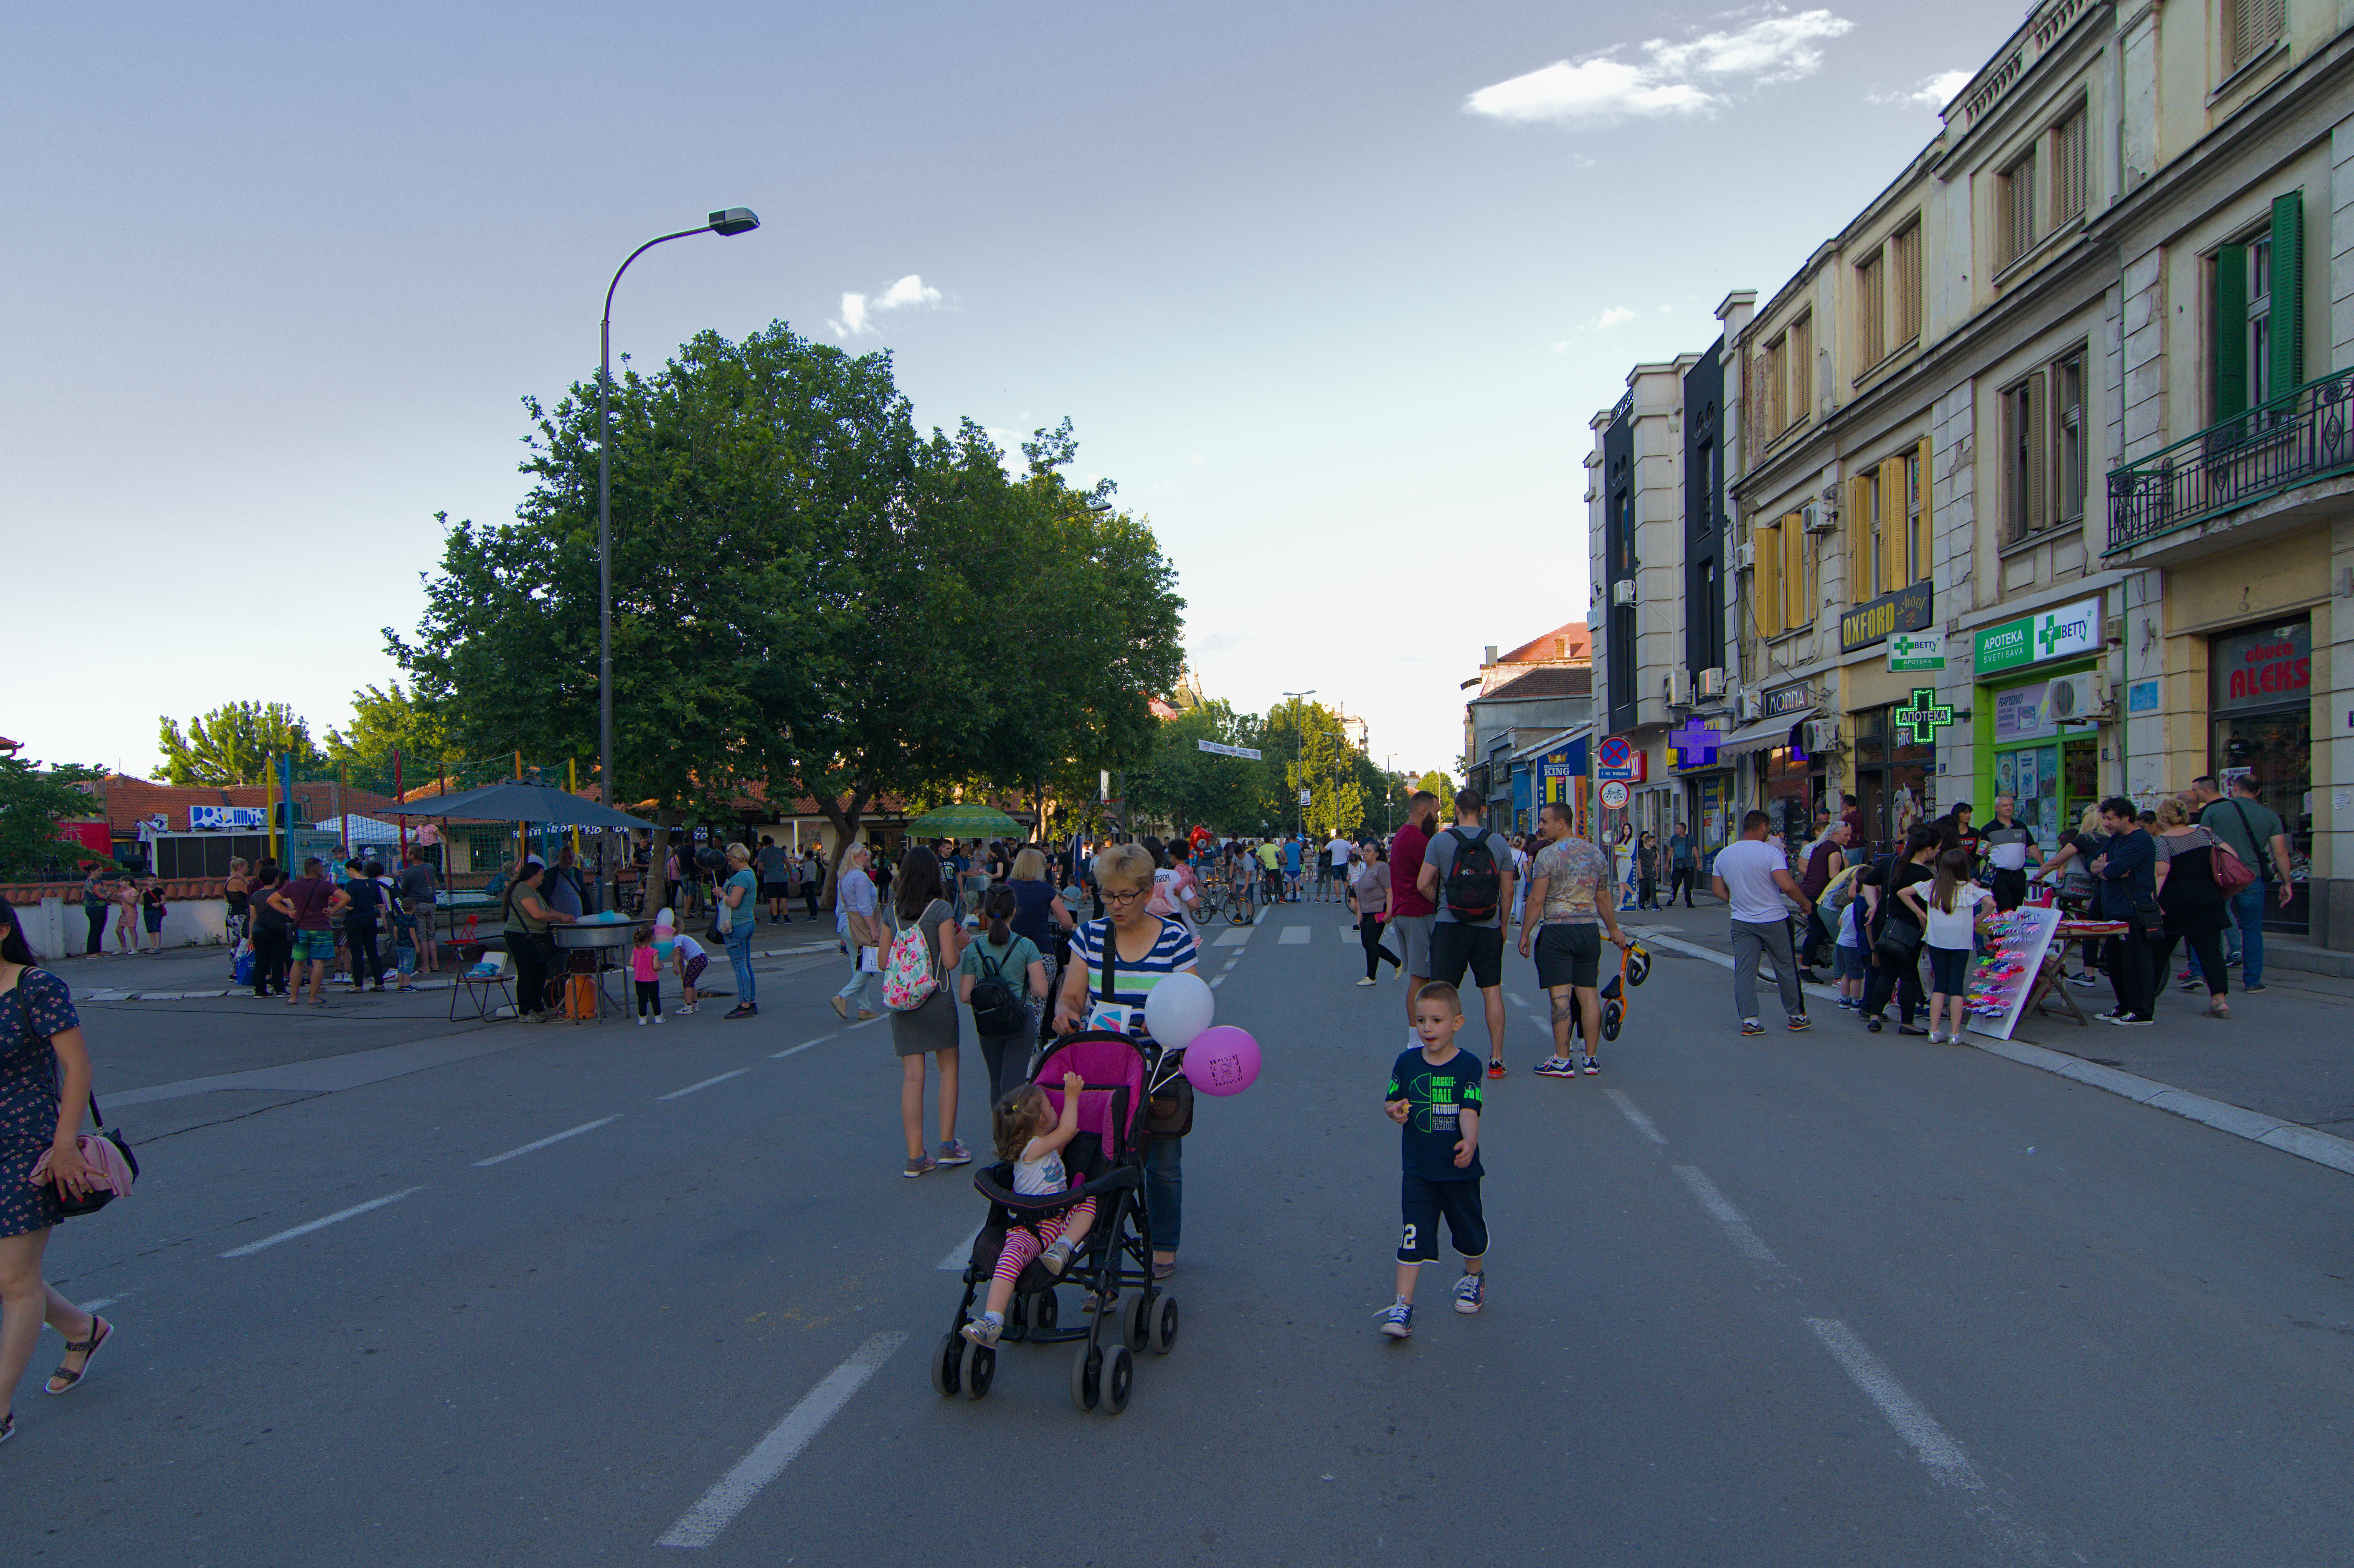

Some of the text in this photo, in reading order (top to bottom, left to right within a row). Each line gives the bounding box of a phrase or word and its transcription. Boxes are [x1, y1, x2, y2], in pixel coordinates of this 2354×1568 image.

[1843, 602, 1895, 647] OXFORD
[1896, 593, 1927, 619] school
[2062, 618, 2089, 642] BETTY
[1915, 640, 1938, 652] BETTY
[1984, 629, 2024, 651] APOTEKA
[1984, 647, 2024, 664] SVETI SAVA
[2245, 639, 2293, 663] obuća
[1770, 690, 1805, 714] MONNA
[1998, 693, 2024, 707] RAPIDNO
[1901, 710, 1947, 722] АПОТЕКА
[1544, 767, 1570, 776] KING
[1432, 1076, 1457, 1087] BASKET-
[1432, 1088, 1452, 1103] BALL
[1432, 1116, 1456, 1131] GAME
